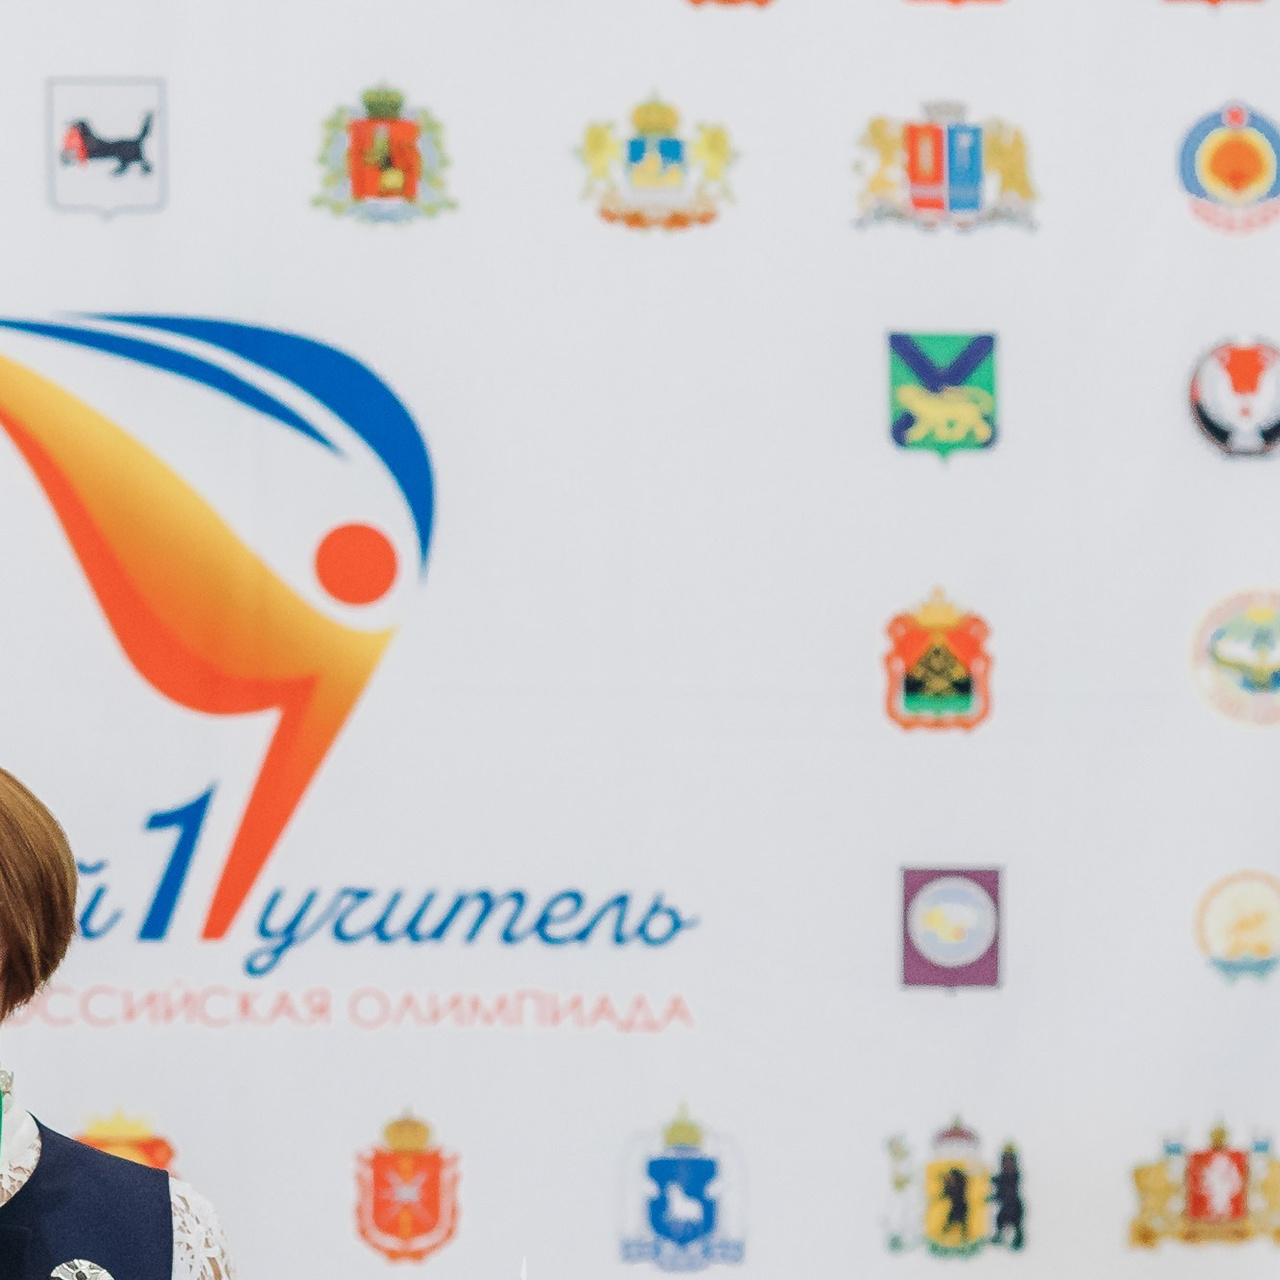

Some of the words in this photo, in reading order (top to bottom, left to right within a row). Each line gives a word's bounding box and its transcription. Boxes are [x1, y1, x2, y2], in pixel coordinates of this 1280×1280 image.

[77, 859, 124, 941] й
[138, 780, 218, 943] 1
[243, 887, 700, 978] учитель
[1, 977, 332, 1029] ОССИЙСКАЯ
[347, 985, 696, 1034] ОЛИМПИАДА
